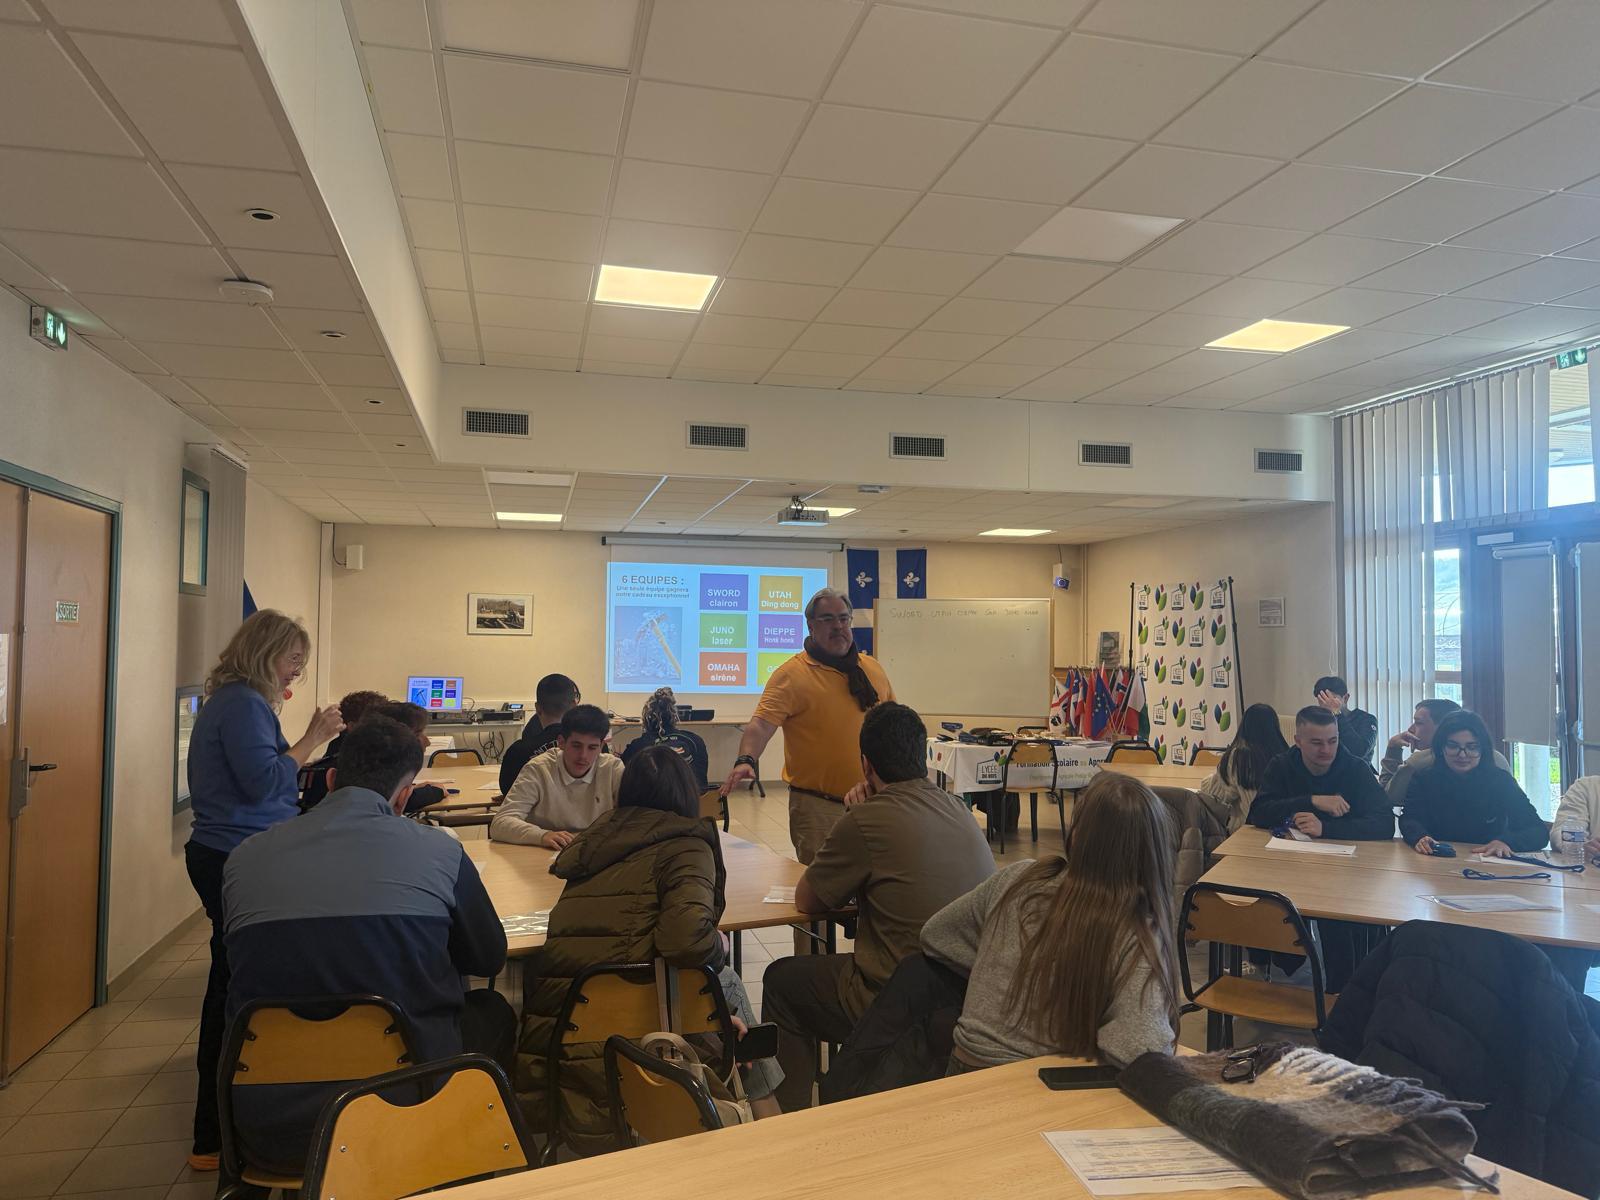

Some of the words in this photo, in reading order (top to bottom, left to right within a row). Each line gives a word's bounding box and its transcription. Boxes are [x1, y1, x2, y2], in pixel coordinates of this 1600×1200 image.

[621, 575, 628, 584] 6
[631, 575, 678, 585] EQUIPES
[707, 588, 741, 597] SWORD
[768, 591, 792, 599] UTAH
[761, 600, 778, 609] Ding
[780, 600, 799, 609] dong
[59, 604, 77, 620] SORTIE
[710, 626, 735, 634] JUNO
[763, 627, 796, 636] DIEPPE
[712, 636, 733, 645] laser
[707, 663, 740, 672] OMAHA
[710, 674, 737, 682] sirène
